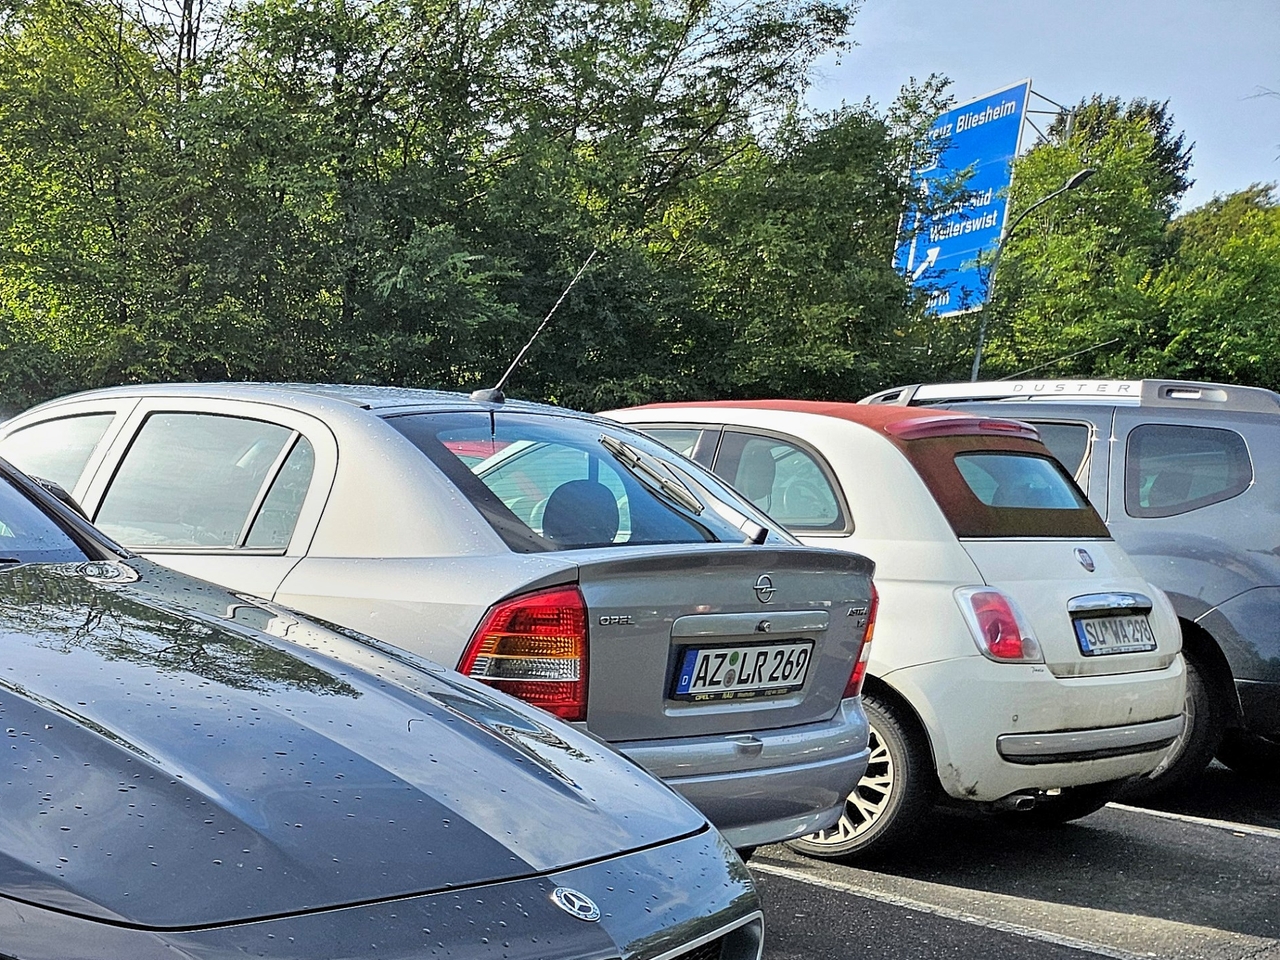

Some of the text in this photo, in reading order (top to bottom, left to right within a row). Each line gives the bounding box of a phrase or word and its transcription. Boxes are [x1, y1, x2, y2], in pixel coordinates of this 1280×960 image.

[925, 101, 1016, 141] reuz Bliesheim
[930, 210, 998, 242] Weilerswist
[1013, 383, 1131, 393] DUSTER
[600, 615, 636, 625] OPEL
[1085, 622, 1107, 646] SU
[1127, 619, 1152, 643] 298
[693, 653, 728, 688] AZ
[737, 651, 768, 685] LR
[768, 648, 808, 682] 269
